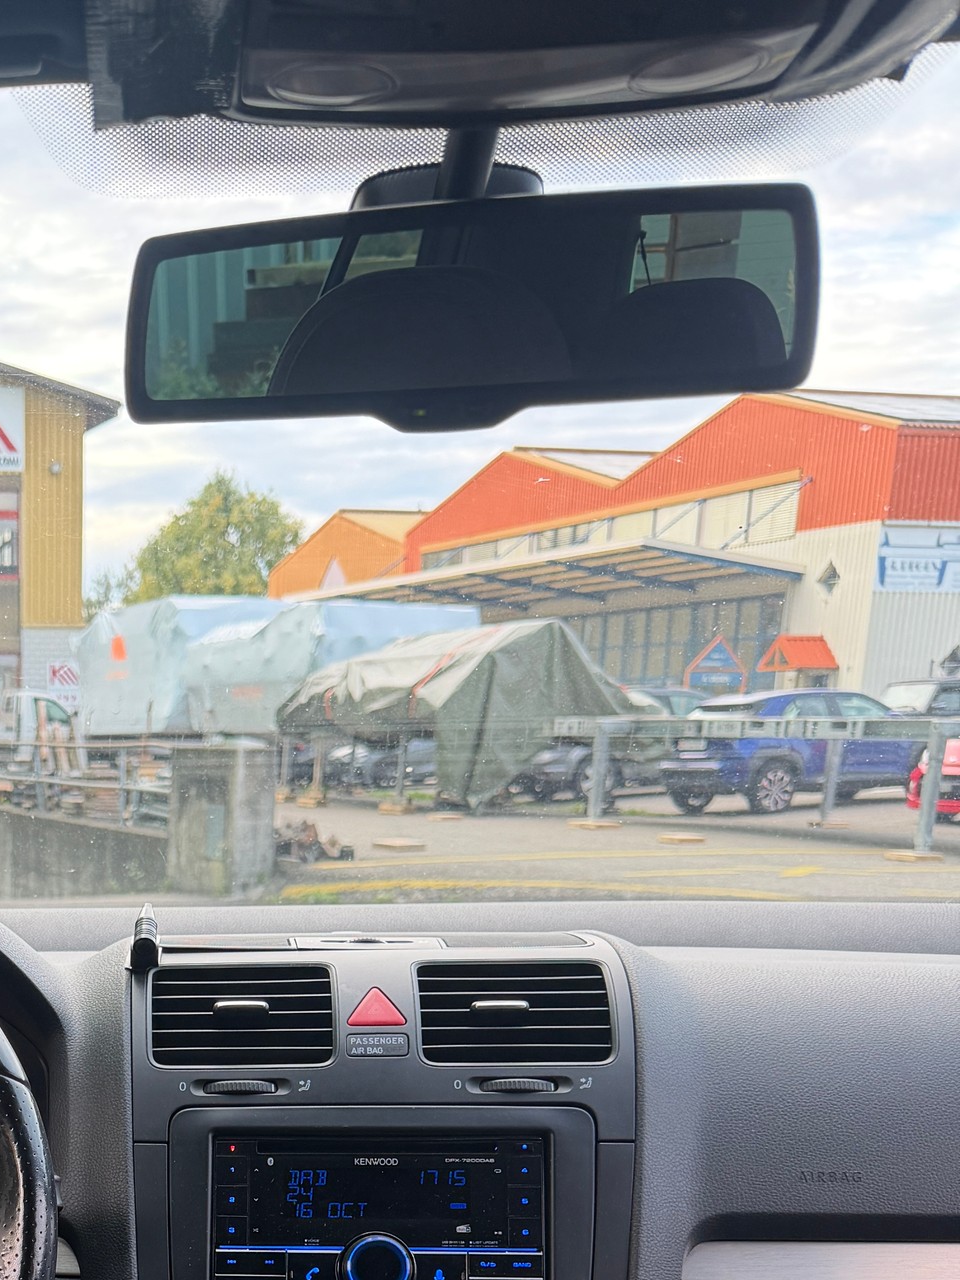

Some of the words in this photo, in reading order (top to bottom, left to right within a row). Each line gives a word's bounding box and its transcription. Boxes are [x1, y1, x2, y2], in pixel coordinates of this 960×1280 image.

[350, 1037, 404, 1045] PASSENGER
[354, 1157, 399, 1166] KENWOOD
[288, 1170, 327, 1186] DAB
[800, 1171, 862, 1183] AIRBAG
[286, 1186, 314, 1202] 24
[295, 1202, 313, 1218] 16
[327, 1202, 367, 1218] OCT
